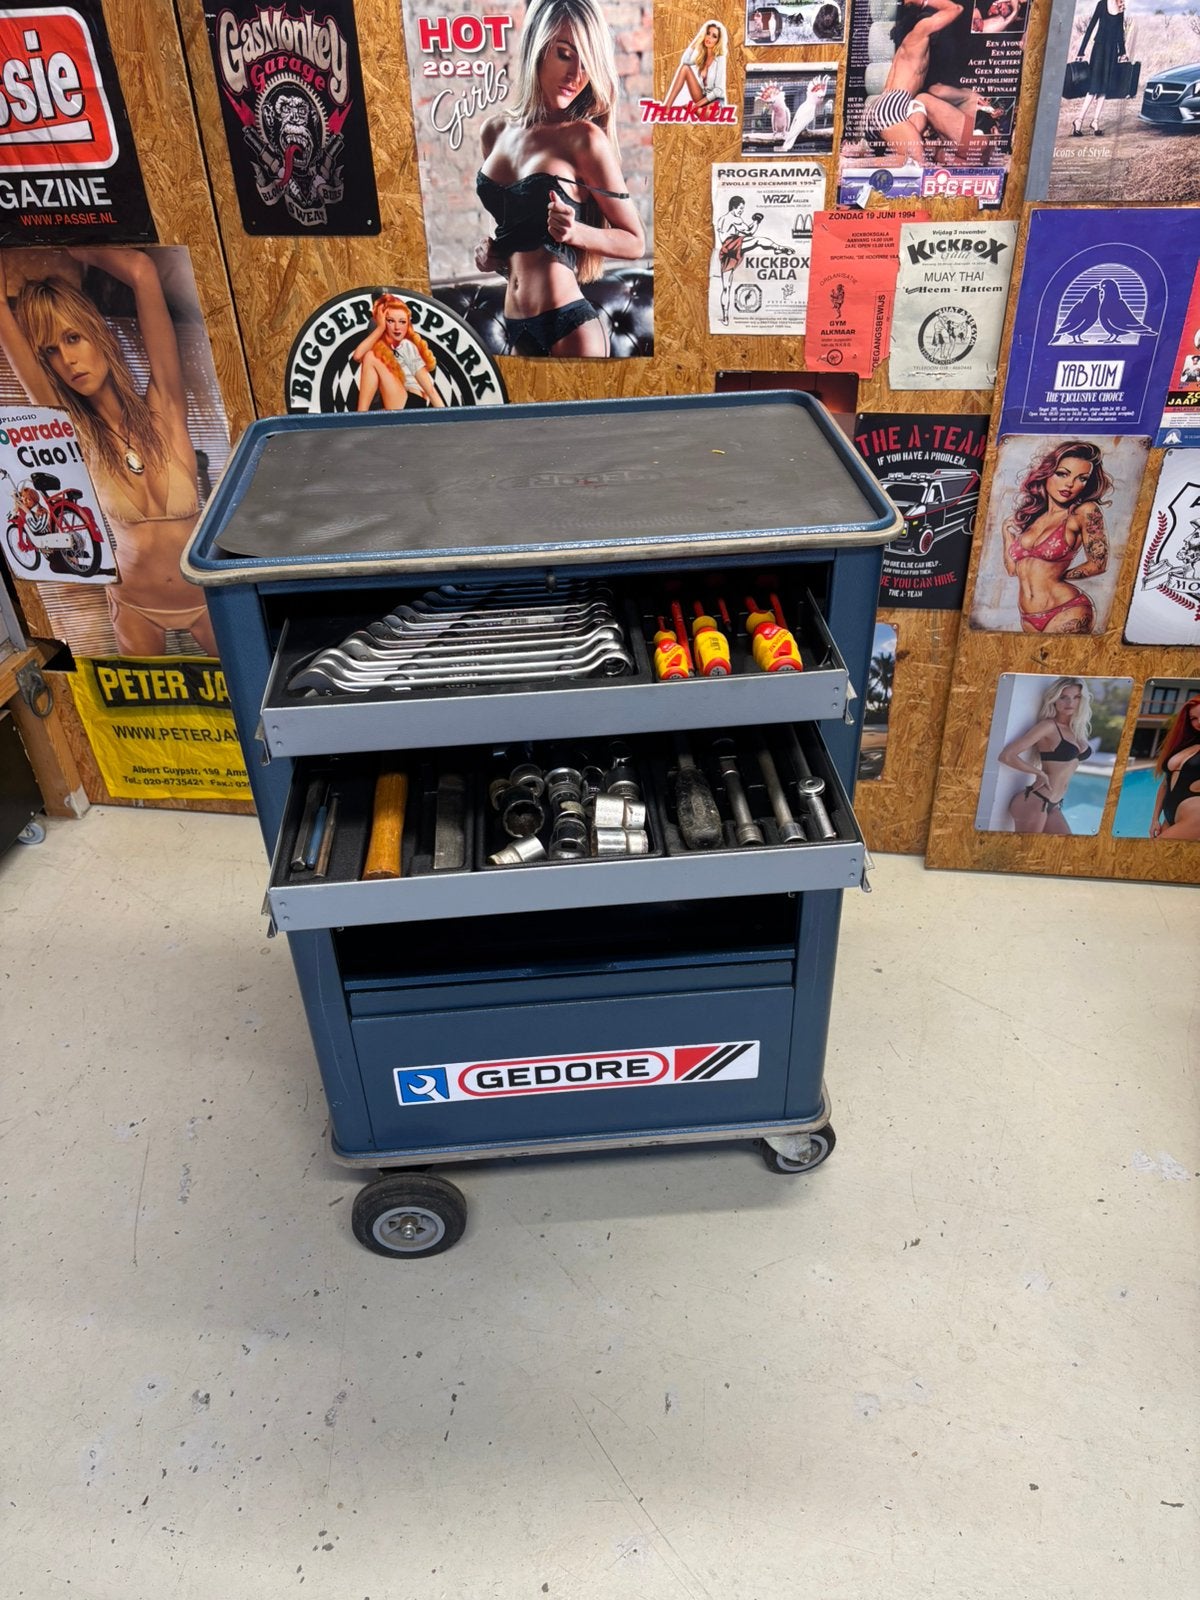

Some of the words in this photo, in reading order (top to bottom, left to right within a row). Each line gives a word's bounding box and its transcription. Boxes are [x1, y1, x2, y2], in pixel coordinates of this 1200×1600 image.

[418, 16, 512, 53] HOT
[251, 55, 327, 94] Garage
[423, 61, 486, 78] 2020
[431, 61, 508, 150] Girls
[1053, 147, 1075, 158] Icons
[1077, 146, 1087, 158] of
[717, 168, 822, 179] PROGRAMMA
[961, 180, 998, 195] FUN
[20, 211, 117, 227] WWW.PASSIE.NL
[829, 212, 863, 220] ZONDAG
[877, 211, 896, 219] JUNI
[745, 257, 810, 269] KICKBOX
[757, 269, 797, 281] GALA
[924, 272, 956, 282] MUAY
[960, 271, 985, 281] THAI
[291, 299, 374, 402] BIGGER
[405, 301, 496, 399] SPARK
[1061, 364, 1089, 388] YAB
[1091, 364, 1119, 387] YUM
[1098, 391, 1125, 402] CHOICE
[855, 426, 900, 457] THE
[877, 456, 886, 466] IF
[886, 453, 901, 464] YOU
[902, 451, 922, 461] HAVE
[924, 451, 930, 460] A
[97, 666, 189, 701] PETER
[133, 765, 160, 774] Albert
[163, 766, 201, 776] Cuypstr.
[476, 1057, 650, 1090] GEDORE
